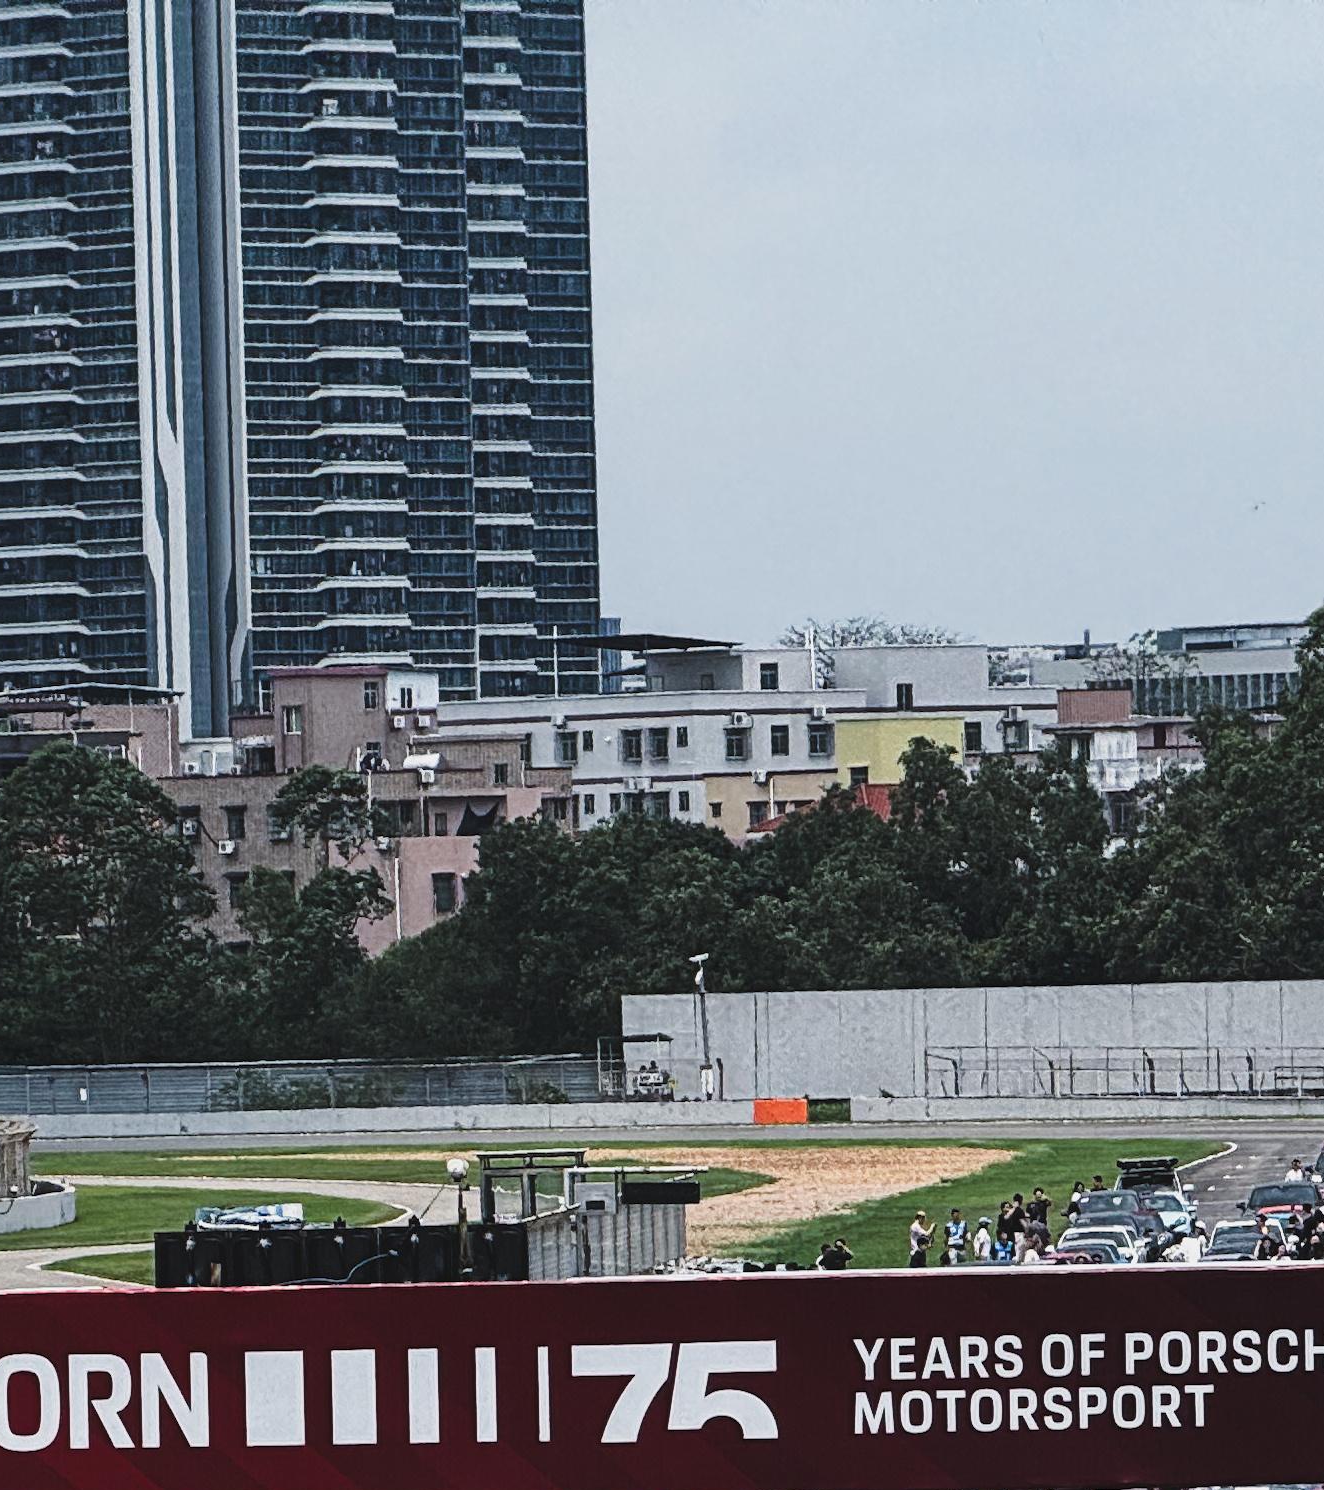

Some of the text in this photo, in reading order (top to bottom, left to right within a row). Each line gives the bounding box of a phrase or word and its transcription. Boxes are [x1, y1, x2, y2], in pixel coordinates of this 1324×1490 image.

[853, 1334, 1024, 1381] YEARS
[1041, 1332, 1106, 1378] OF
[571, 1339, 779, 1444] 75
[854, 1383, 1215, 1435] MOTORSPORT
